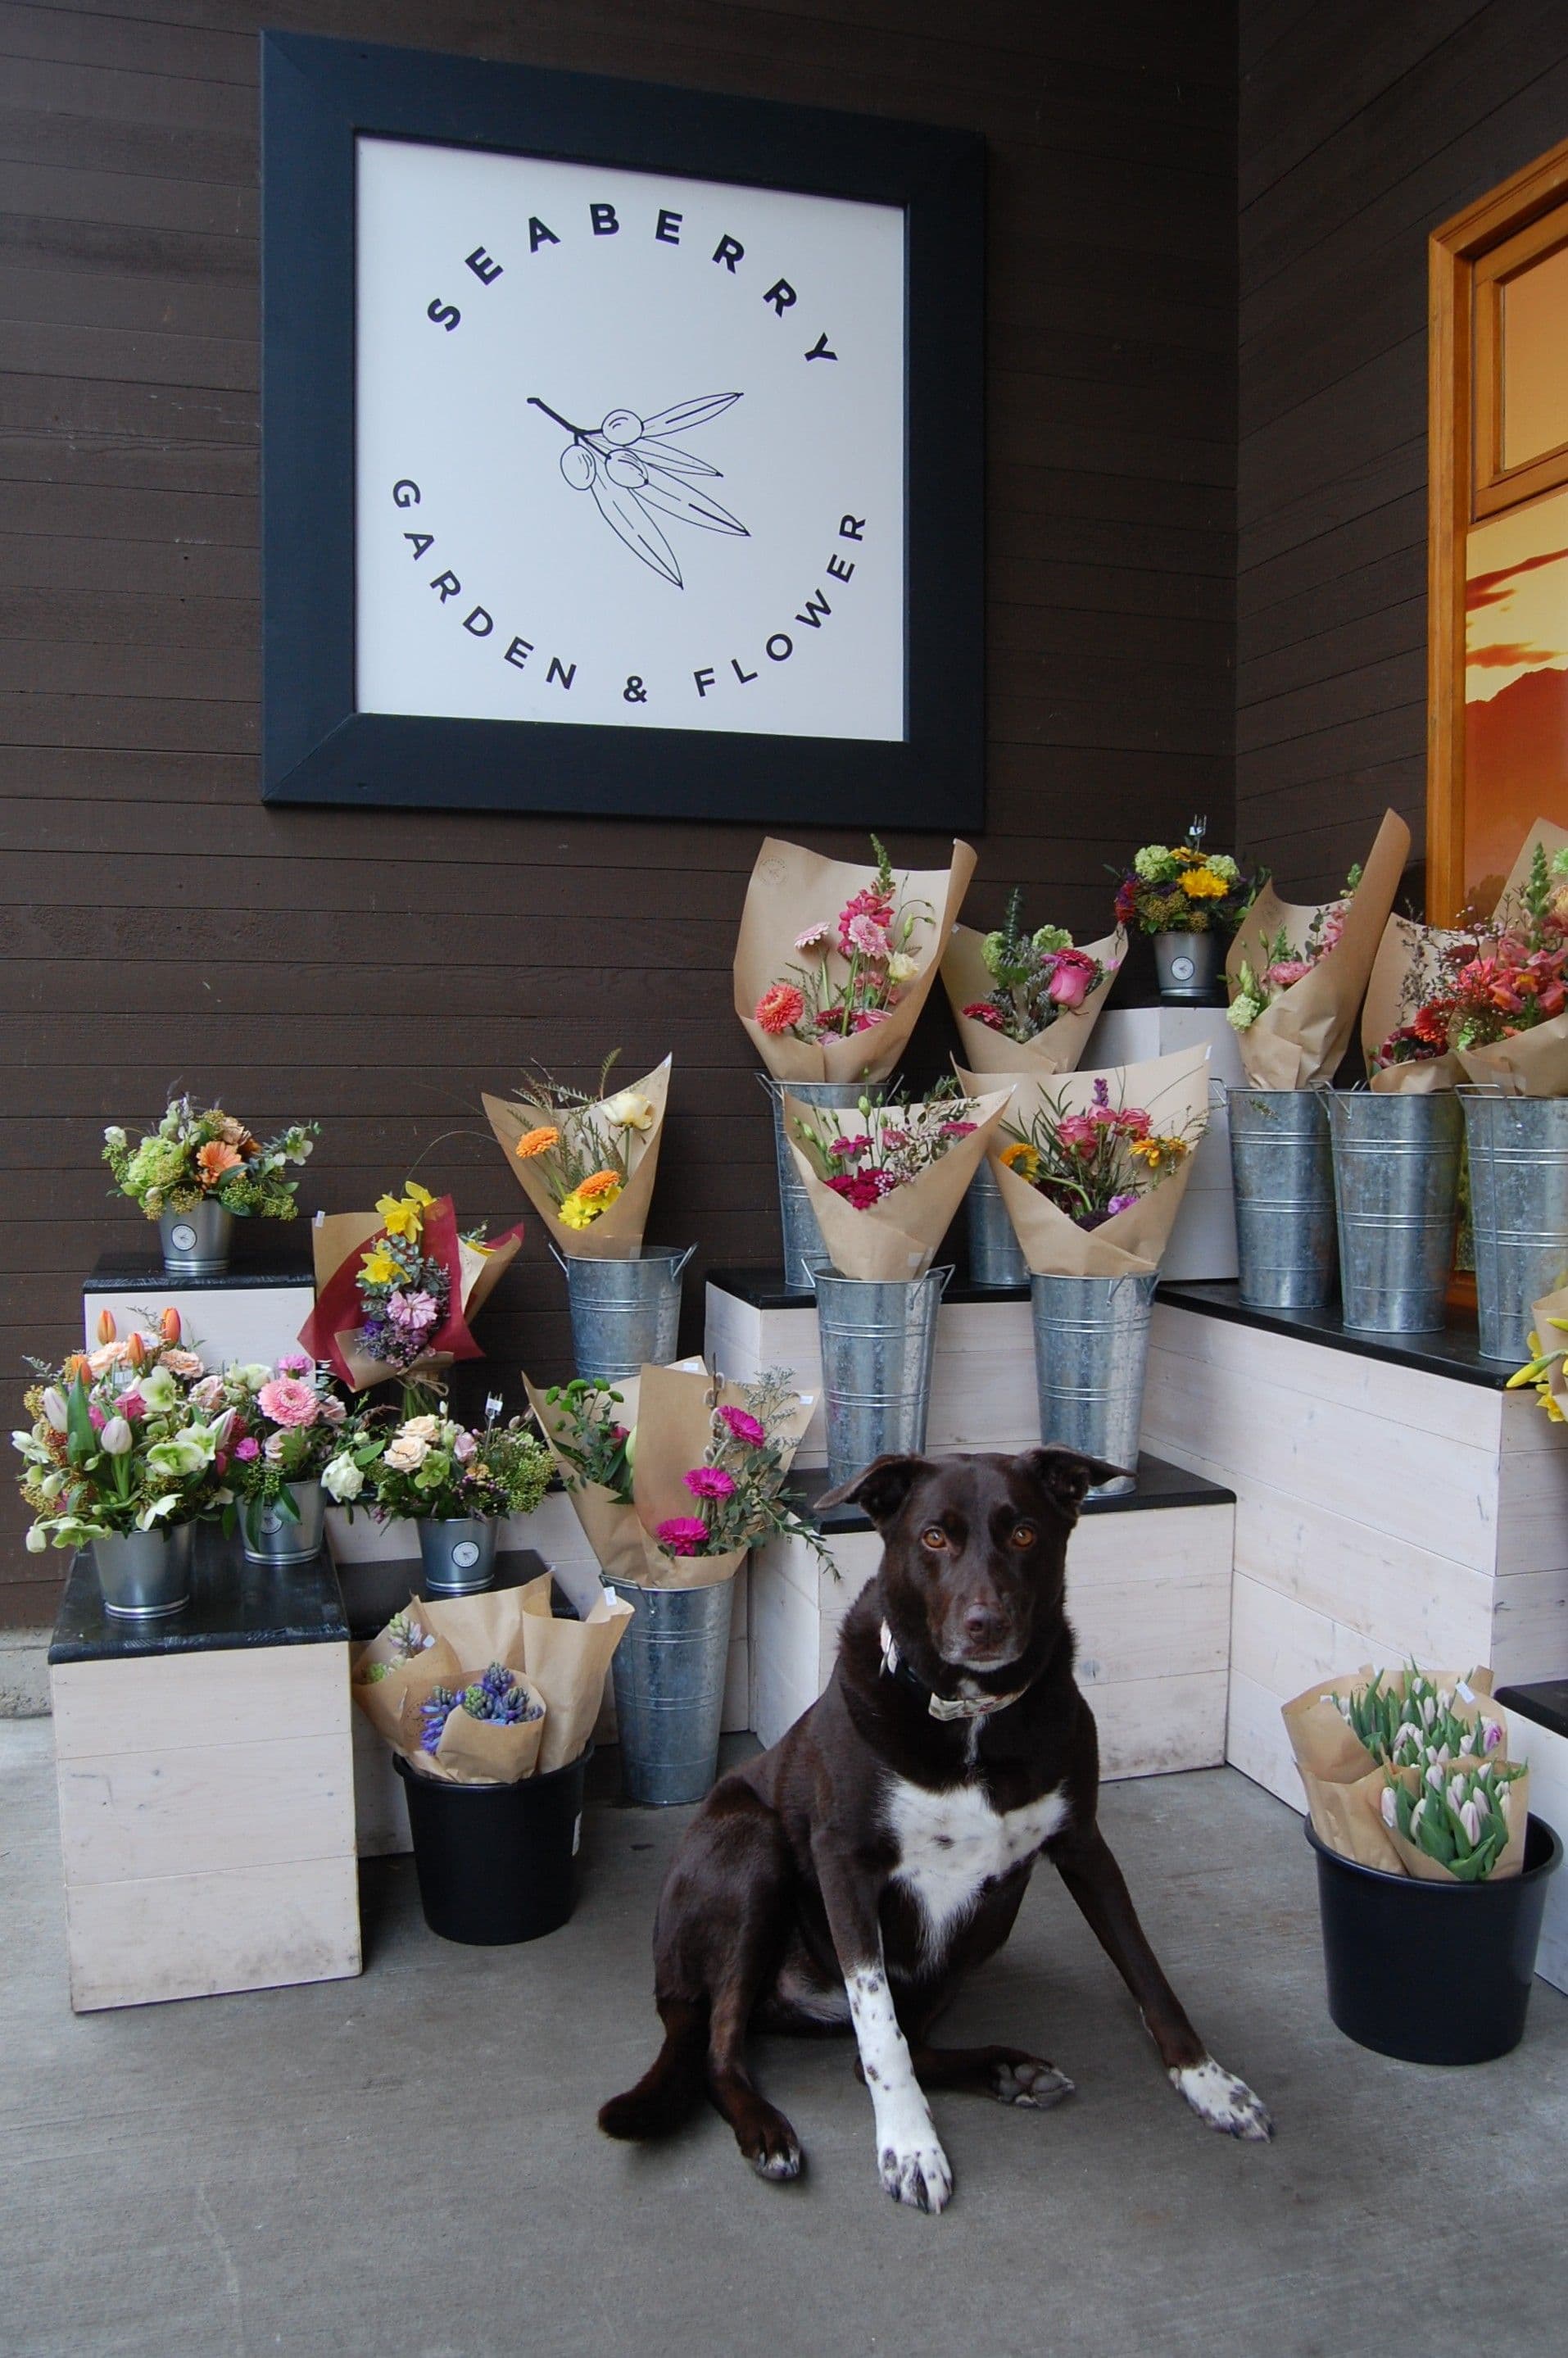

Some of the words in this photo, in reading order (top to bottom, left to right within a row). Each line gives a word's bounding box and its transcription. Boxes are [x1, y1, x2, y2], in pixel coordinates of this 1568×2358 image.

[427, 202, 839, 366] SEABERRY
[392, 478, 578, 691] GARDEN
[623, 675, 647, 703] &
[693, 514, 867, 698] FLOWER
